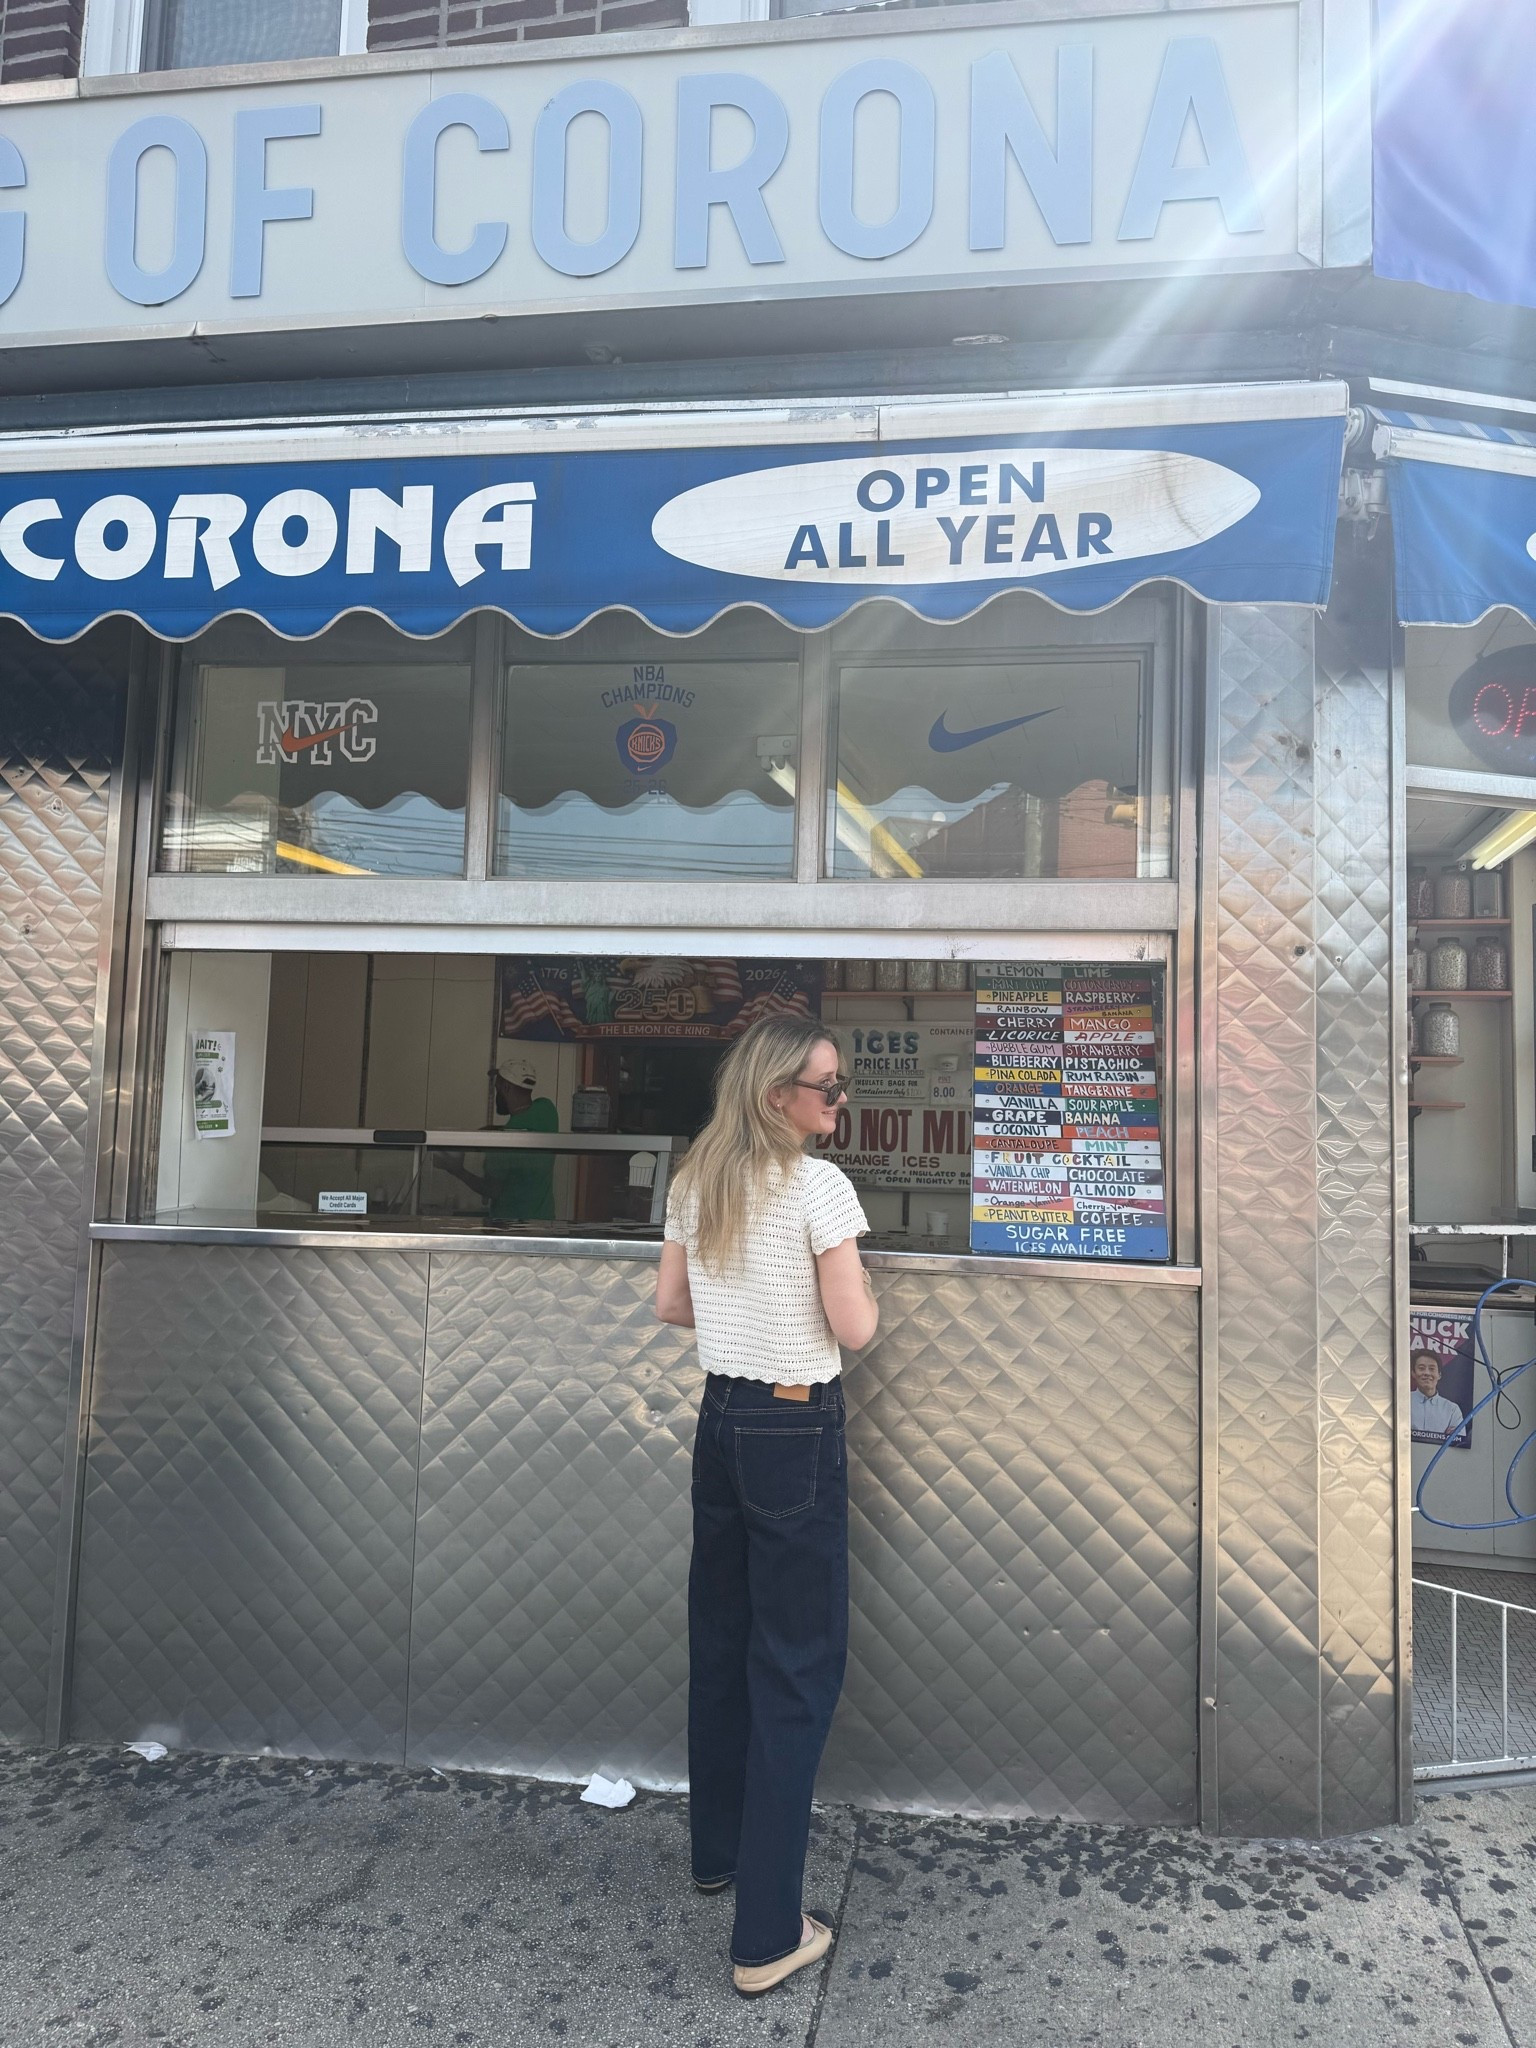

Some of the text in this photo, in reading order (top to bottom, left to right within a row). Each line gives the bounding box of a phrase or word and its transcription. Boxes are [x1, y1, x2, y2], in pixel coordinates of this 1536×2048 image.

[105, 104, 322, 306] OF
[401, 37, 1264, 286] CORONA
[856, 461, 1045, 512] OPEN
[0, 482, 536, 591] CORONA
[784, 513, 1114, 570] ALL YEAR
[633, 666, 665, 683] NBA
[601, 683, 696, 708] CHAMPIONS
[256, 698, 378, 765] NYC
[631, 735, 660, 752] KNICKS
[541, 967, 568, 980] 1776
[745, 969, 780, 981] 2026
[997, 966, 1044, 977] LEMON
[1074, 968, 1112, 978] LIME
[992, 991, 1049, 1002] PINEAPPLE
[1066, 992, 1136, 1004] RASPBERRY
[615, 988, 697, 1021] 250
[997, 1006, 1048, 1014] RAINBOW
[1066, 1004, 1121, 1013] STRAWBERRY
[997, 1017, 1056, 1028] CHERRY
[1070, 1018, 1131, 1030] MANGO
[600, 1025, 711, 1036] THE LEMON ICE KING
[988, 1031, 1061, 1041] LICORICE
[1074, 1032, 1136, 1042] APPLE
[196, 1039, 218, 1051] AIT!
[852, 1028, 920, 1055] ICES
[990, 1042, 1056, 1055] BUBBLE GUM
[1065, 1044, 1140, 1057] STRAWBERRY
[854, 1058, 919, 1070] PRICE LIST
[991, 1056, 1058, 1068] BLUEBERRY
[1065, 1057, 1140, 1070] PISTACHIO
[990, 1069, 1057, 1081] PINA COLADA
[1066, 1071, 1140, 1083] RUM RAISIN
[933, 1086, 955, 1098] 8.00
[995, 1083, 1044, 1095] ORANGE
[1065, 1085, 1133, 1097] TANGERINE
[999, 1096, 1059, 1110] VANILLA
[1069, 1099, 1135, 1112] SOUR APPLE
[992, 1110, 1047, 1123] GRAPE
[1065, 1113, 1121, 1126] BANANA
[860, 1108, 912, 1153] NOT
[923, 1110, 972, 1155] MI
[992, 1124, 1049, 1136] COCONUT
[1076, 1126, 1130, 1139] PEACH
[989, 1139, 1059, 1150] CANTALOUPE
[1085, 1141, 1129, 1152] MINT
[823, 1154, 890, 1166] EXCHANGE
[902, 1157, 940, 1168] ICES
[991, 1151, 1131, 1167] FRUIT COCKTAIL
[909, 1170, 956, 1178] INSULATED
[988, 1166, 1051, 1179] VANILLA CHIP
[1069, 1170, 1145, 1183] CHOCOLATE
[988, 1180, 1062, 1194] WATERMELON
[1073, 1184, 1136, 1197] ALMOND
[990, 1196, 1063, 1208] Orange-Vanilla
[988, 1209, 1072, 1223] PEANUT BUTTER
[1080, 1212, 1143, 1226] COFFEE
[1006, 1225, 1127, 1243] SUGAR FREE
[1015, 1242, 1123, 1257] ICES AVAILABLE
